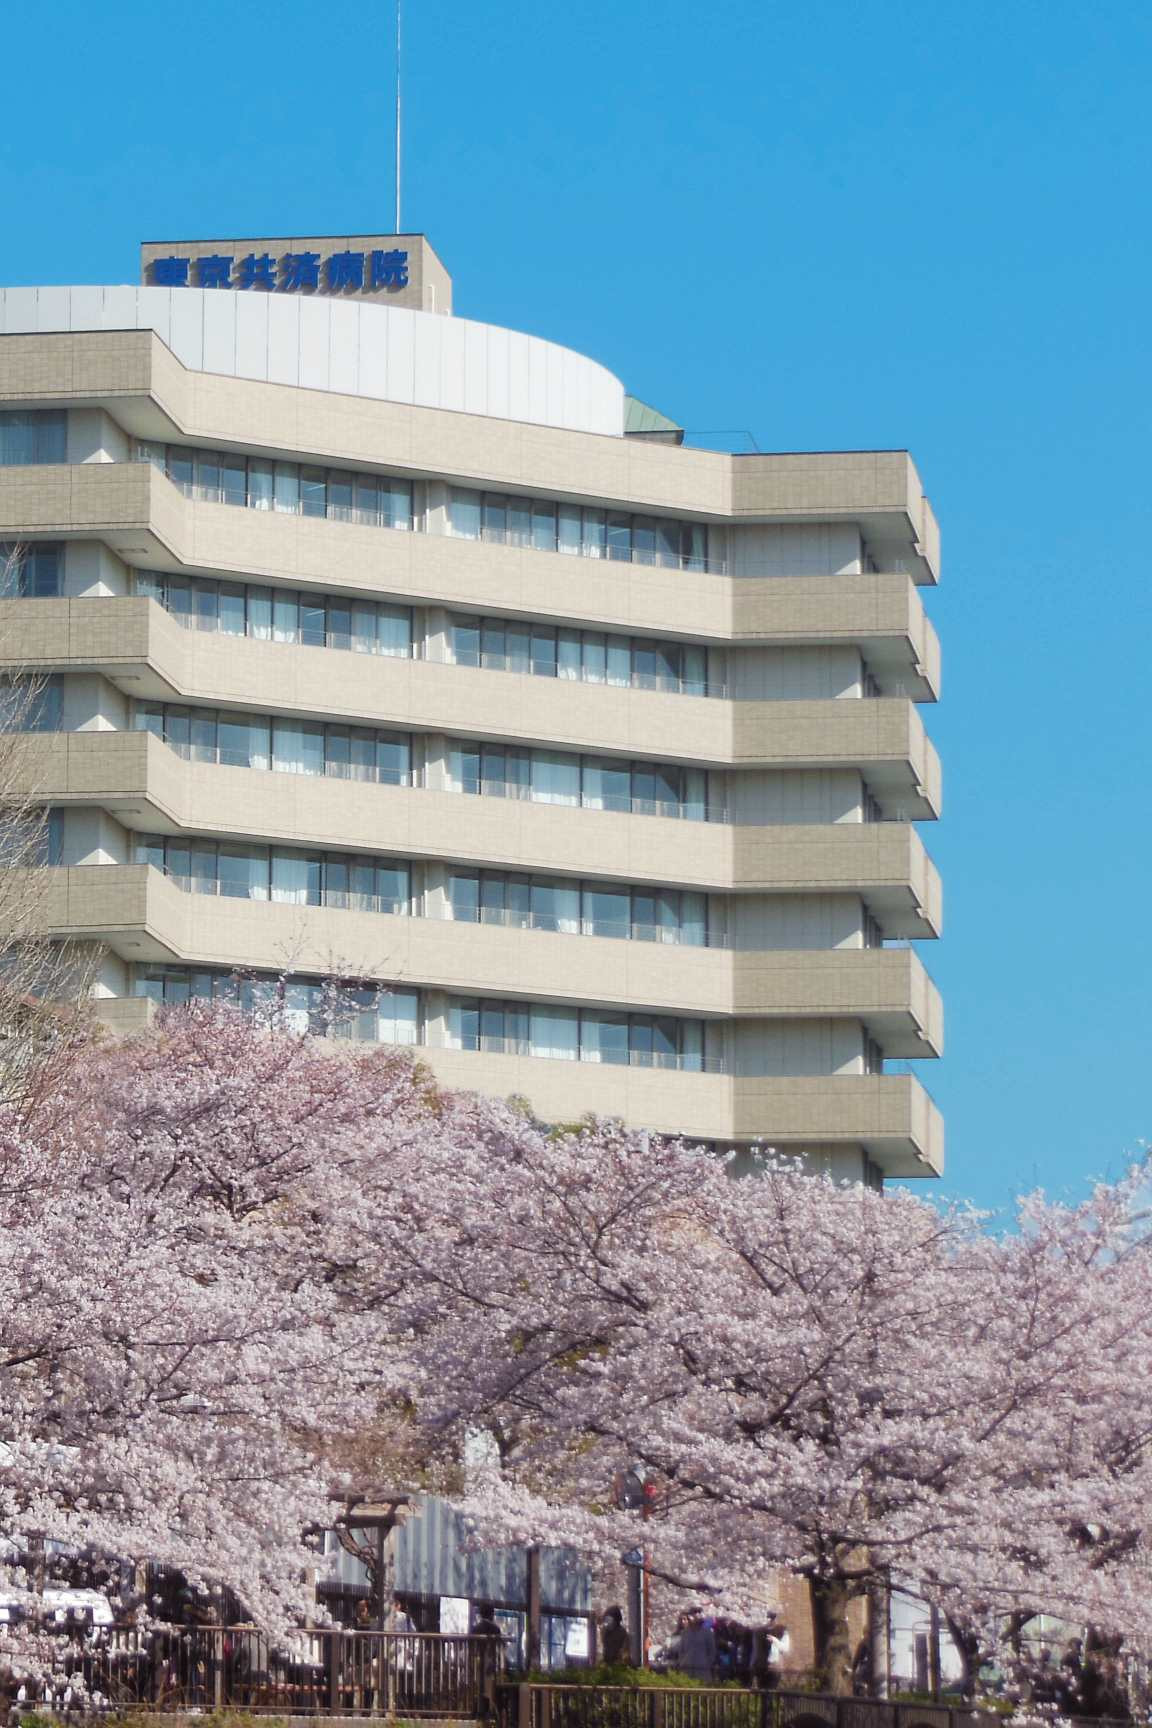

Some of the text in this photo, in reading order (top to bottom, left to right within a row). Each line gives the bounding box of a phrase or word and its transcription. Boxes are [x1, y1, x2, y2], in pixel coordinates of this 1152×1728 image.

[153, 249, 408, 290] 東京共済病院
